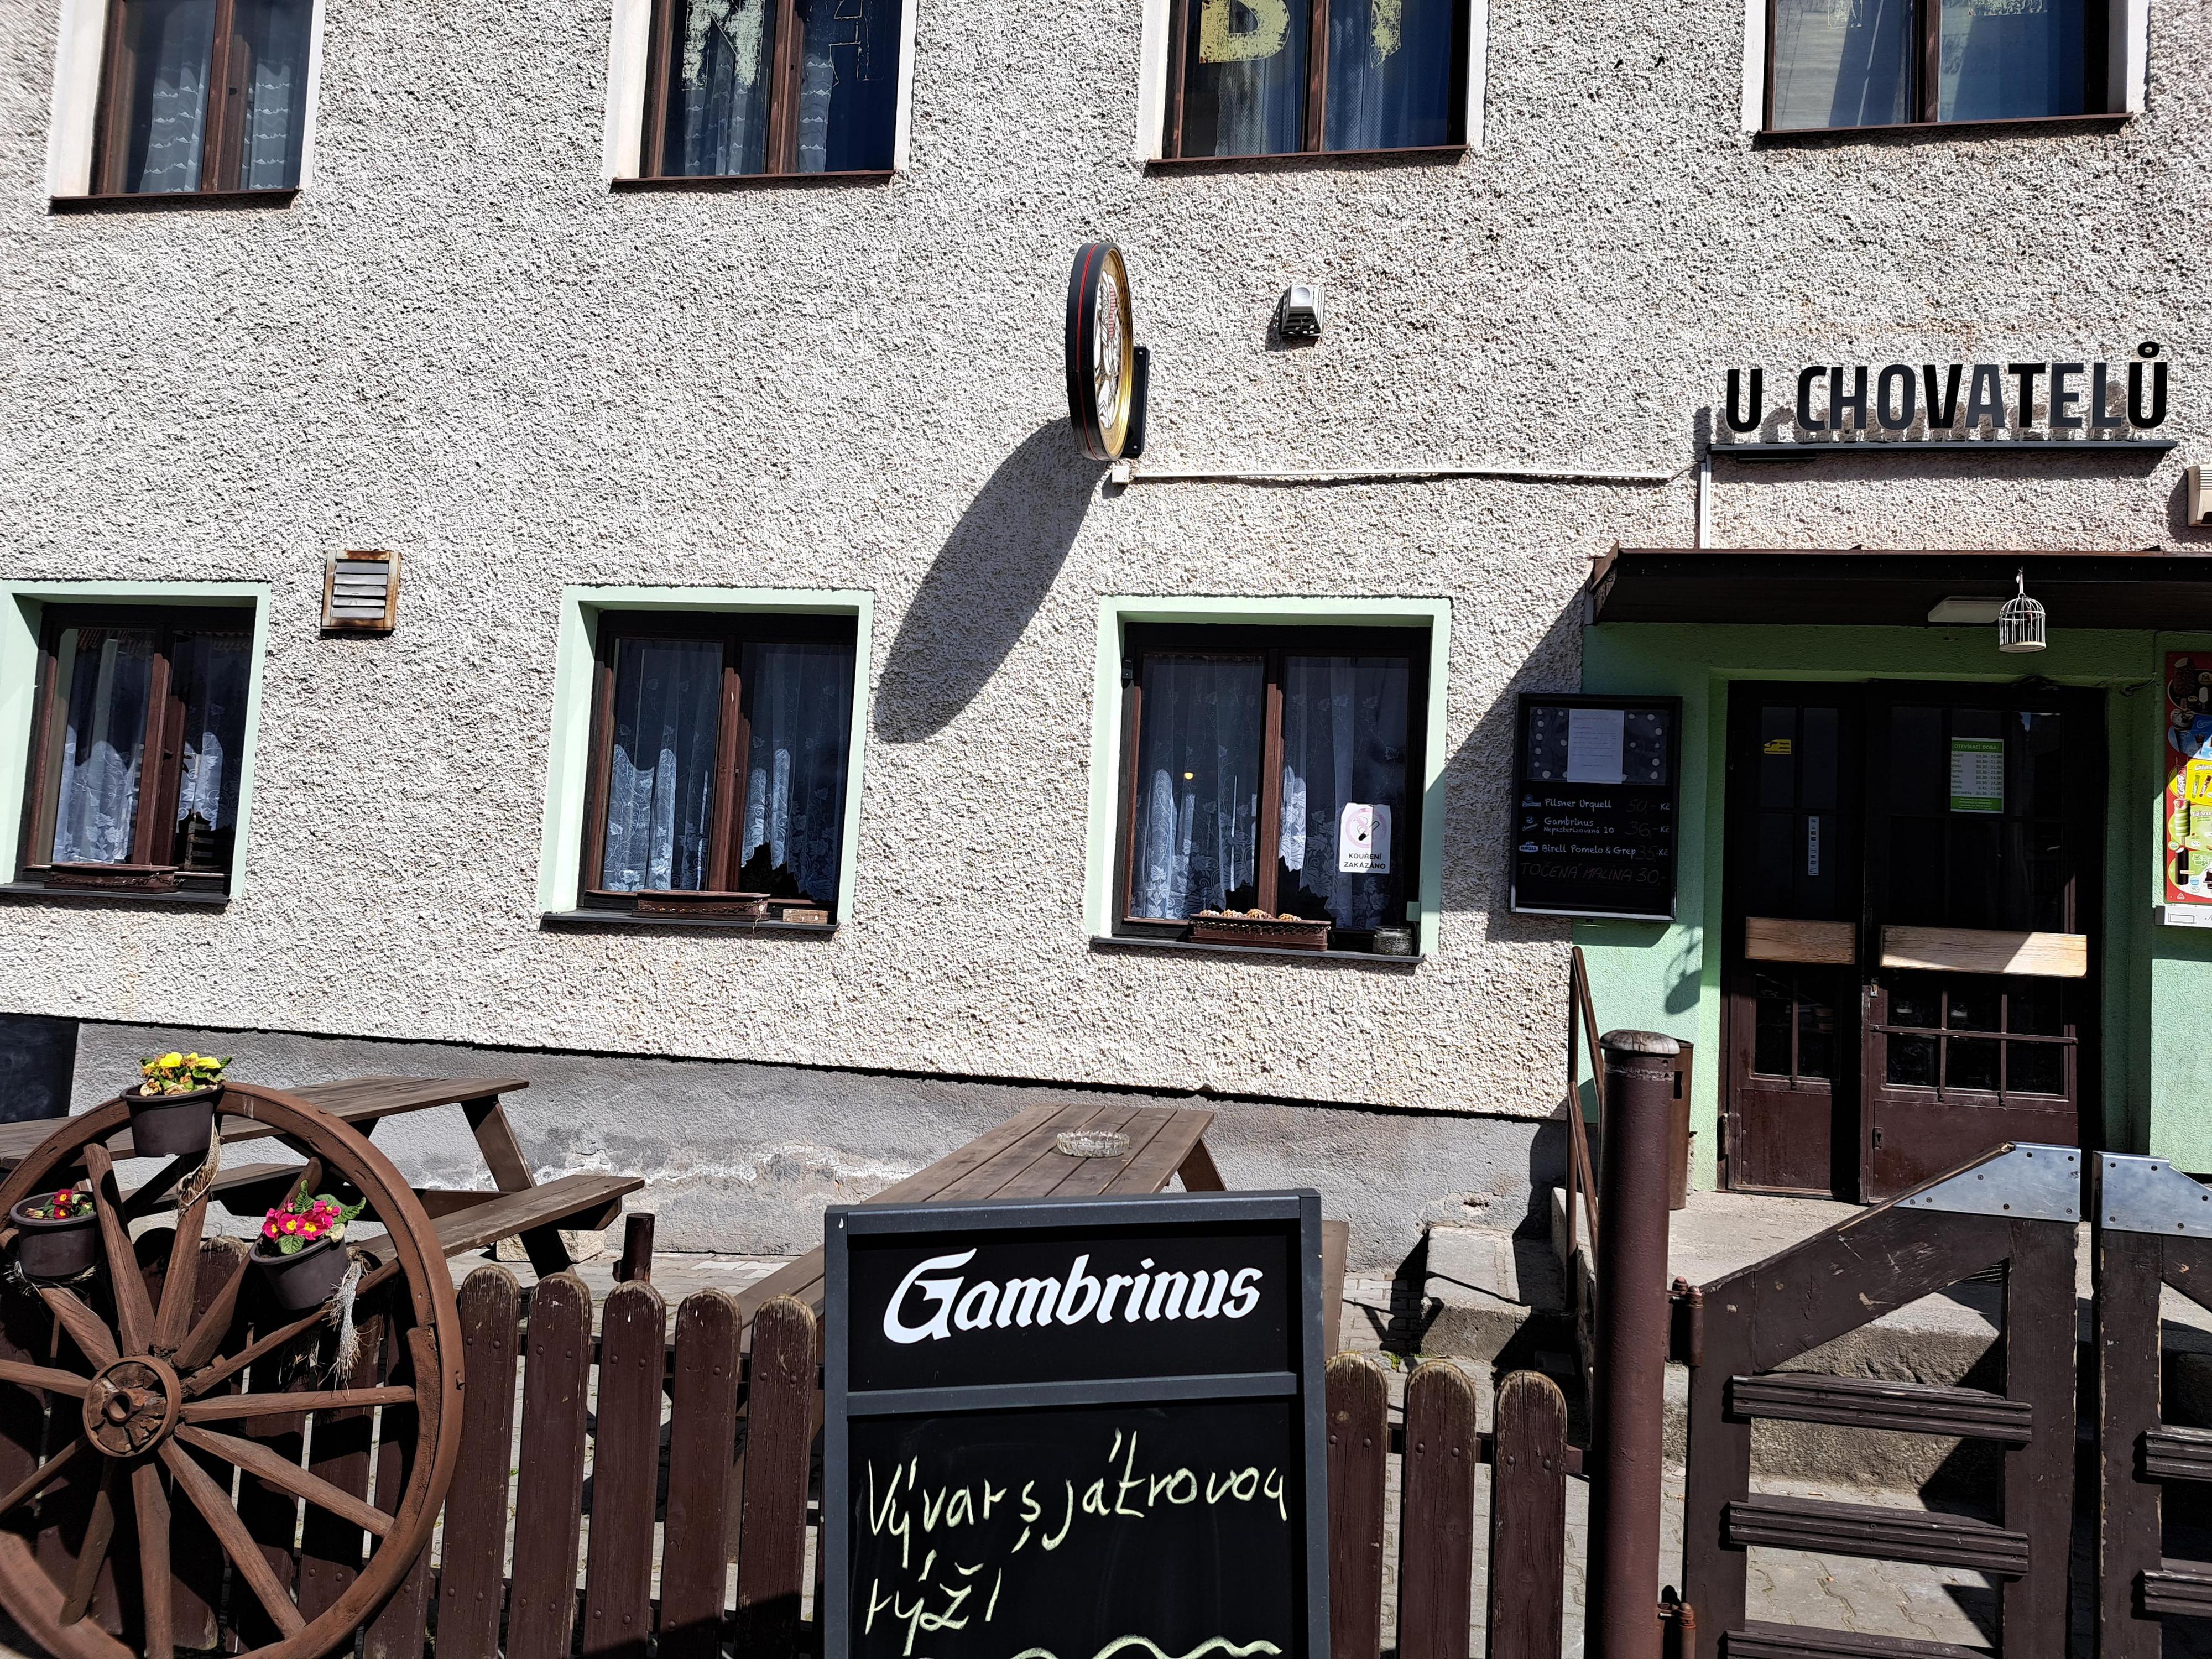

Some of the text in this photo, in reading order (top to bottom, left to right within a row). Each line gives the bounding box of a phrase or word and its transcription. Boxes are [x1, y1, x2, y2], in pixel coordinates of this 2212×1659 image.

[1725, 341, 2168, 433] U CHOVATELŮ
[1545, 798, 1576, 807] Pilsner
[1579, 799, 1611, 812] Urquell
[1660, 802, 1671, 810] Kč
[1543, 816, 1593, 826] Gambrinus
[1660, 825, 1670, 833] Kč
[1571, 845, 1603, 853] Pomelo
[1605, 846, 1611, 854] &
[1613, 847, 1636, 859] Grep
[1658, 848, 1668, 856] Kč
[1343, 861, 1386, 869] ZAKÁZÁNO
[883, 1248, 1264, 1344] Gambrinus
[868, 1455, 1008, 1569] Vývar
